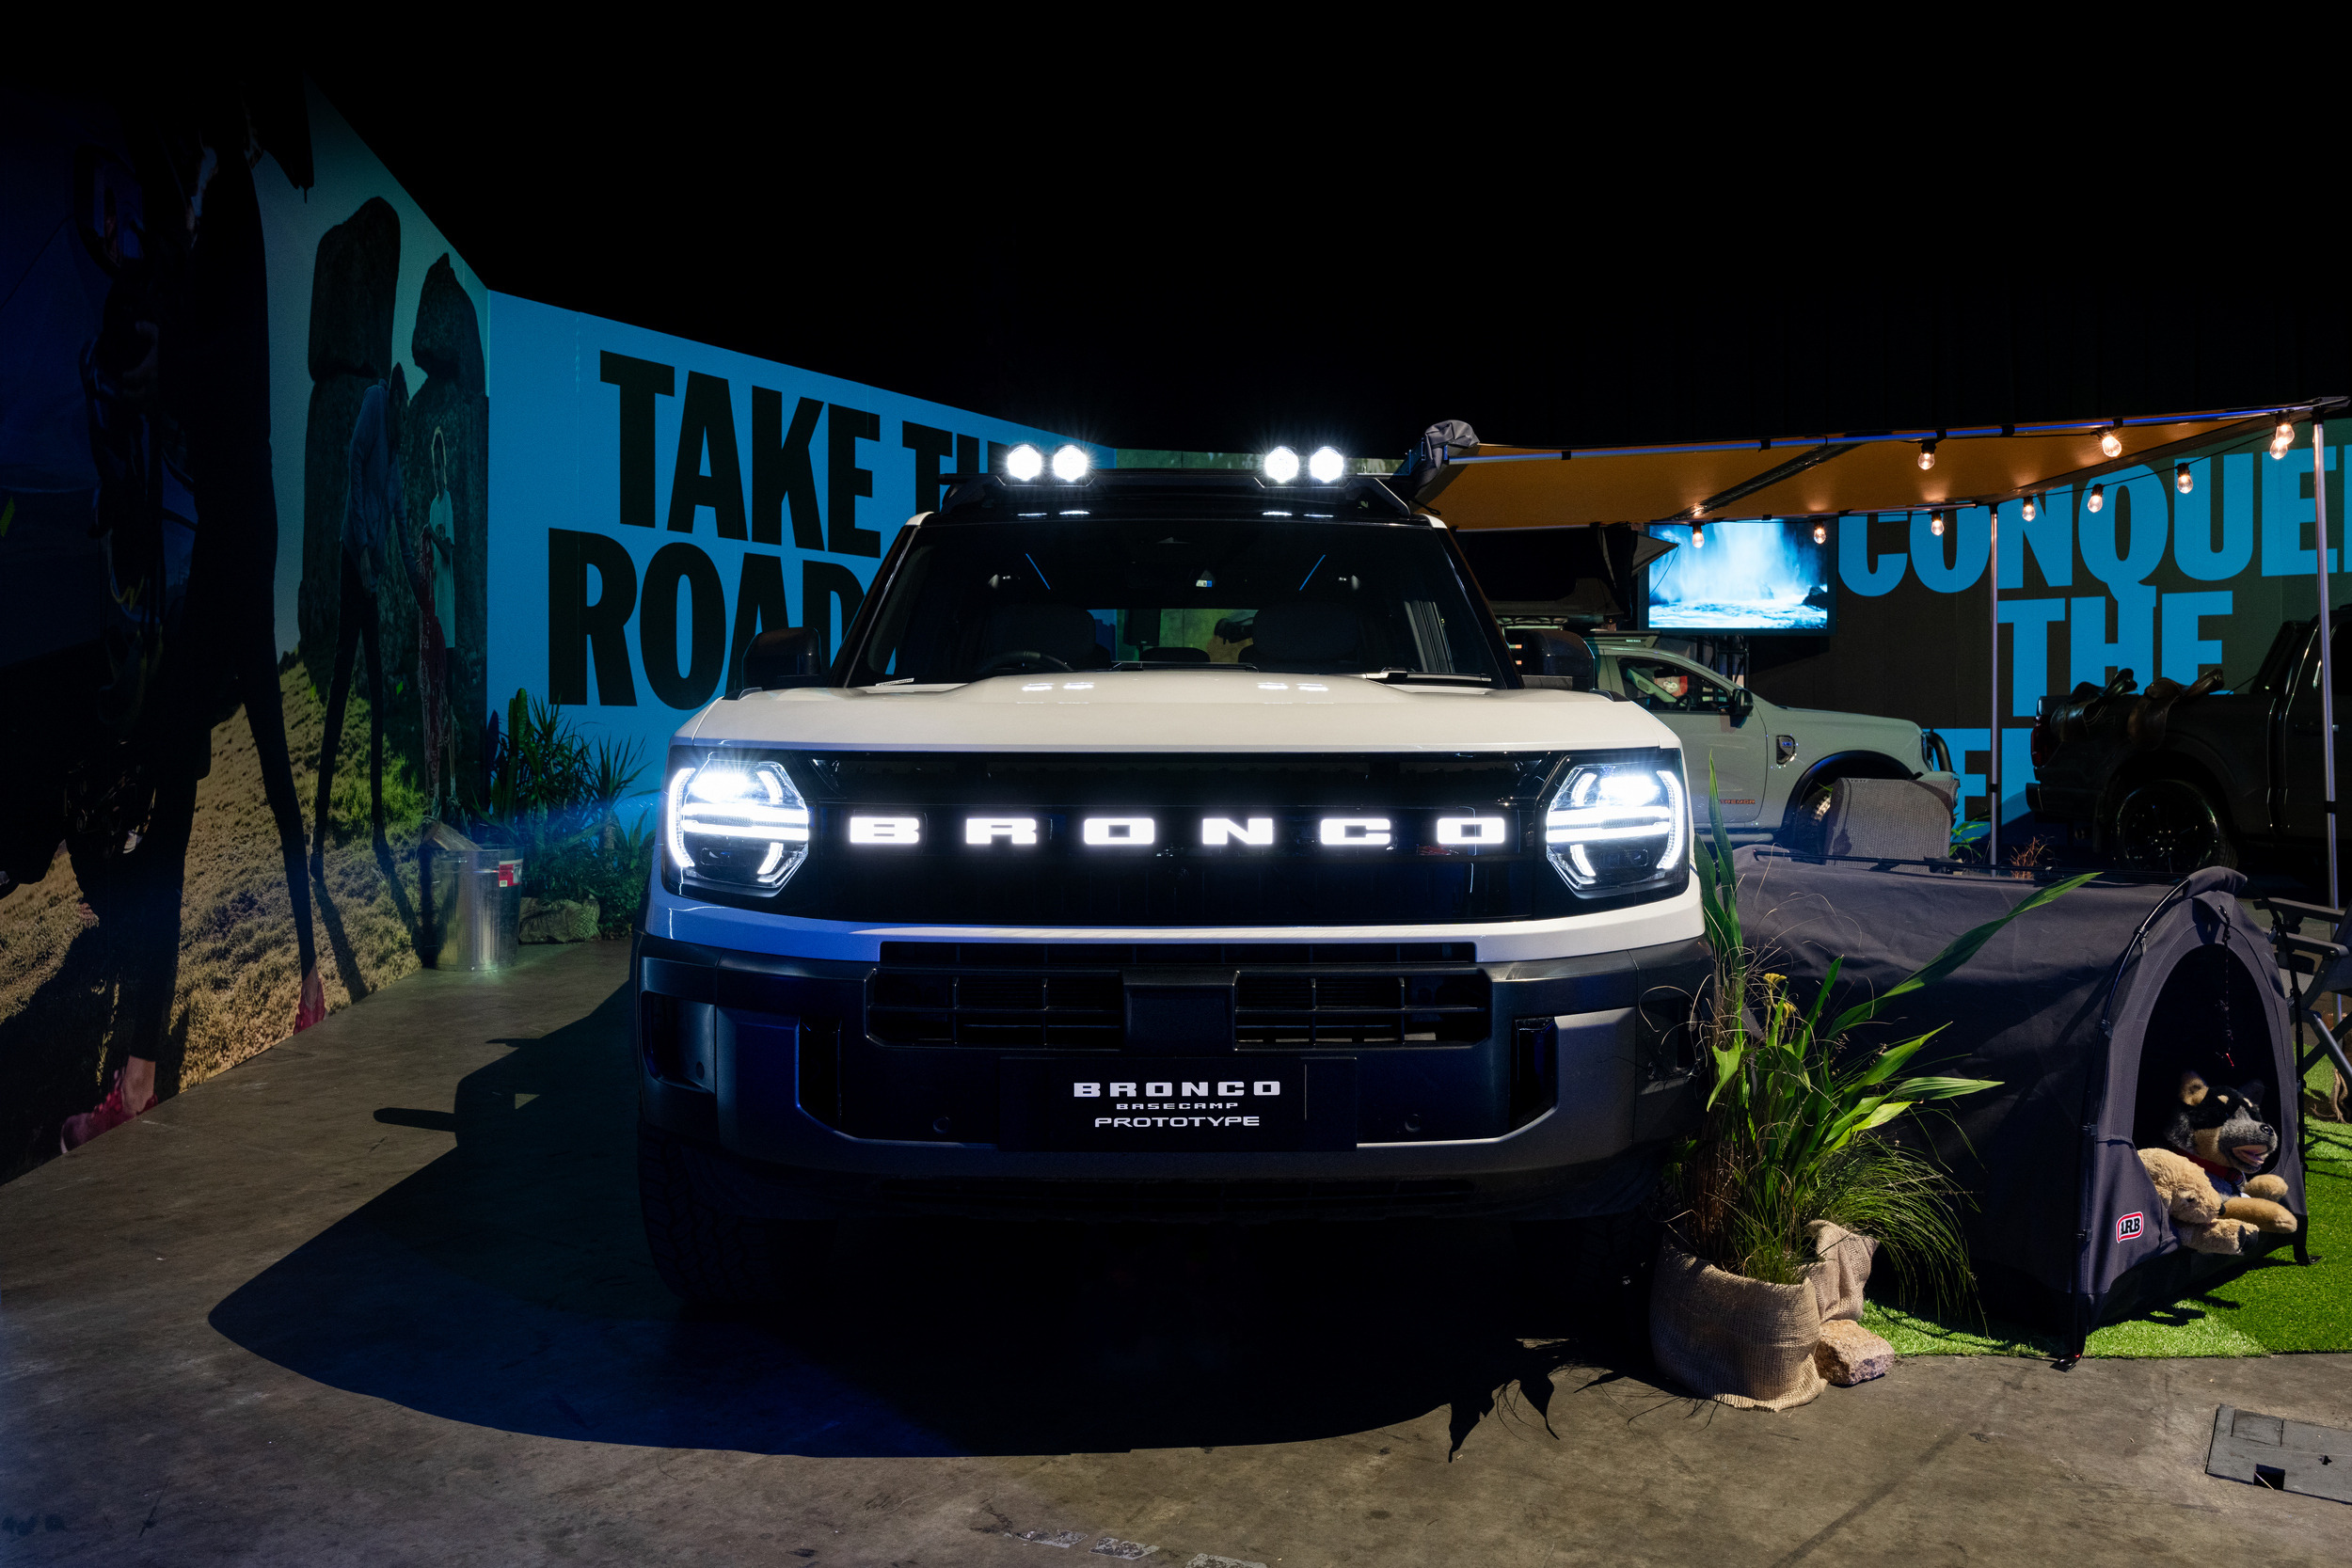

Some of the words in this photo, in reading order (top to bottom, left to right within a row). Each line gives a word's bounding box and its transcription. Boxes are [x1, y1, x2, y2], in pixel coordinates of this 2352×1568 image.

[599, 350, 881, 559] TAKE
[1838, 444, 2352, 608] CONQUE
[1995, 590, 2233, 717] THE
[850, 817, 1505, 845] BRONCO
[1073, 1081, 1280, 1098] BRONCO
[1094, 1116, 1260, 1128] PROTOTYPE
